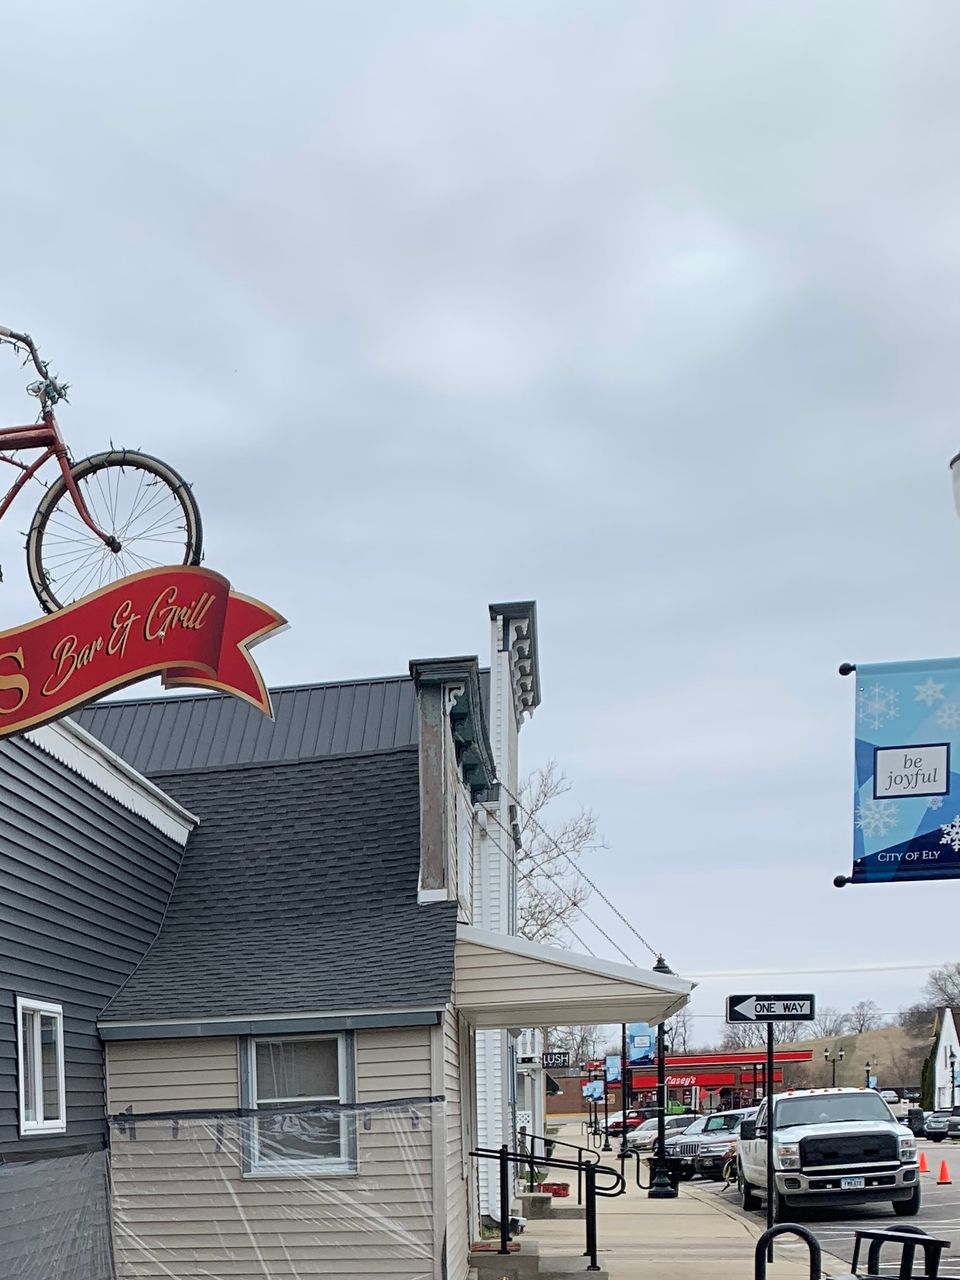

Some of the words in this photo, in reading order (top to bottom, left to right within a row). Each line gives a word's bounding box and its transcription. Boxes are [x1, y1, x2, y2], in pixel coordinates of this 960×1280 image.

[42, 634, 103, 695] Bar
[146, 585, 216, 644] Grill
[903, 753, 923, 769] be
[884, 767, 938, 791] joyful
[877, 852, 904, 862] CITY
[922, 850, 941, 860] ELY
[754, 1002, 776, 1014] ONE
[782, 1001, 806, 1013] WAY
[543, 1054, 569, 1065] LUSH
[665, 1075, 697, 1086] Casey's
